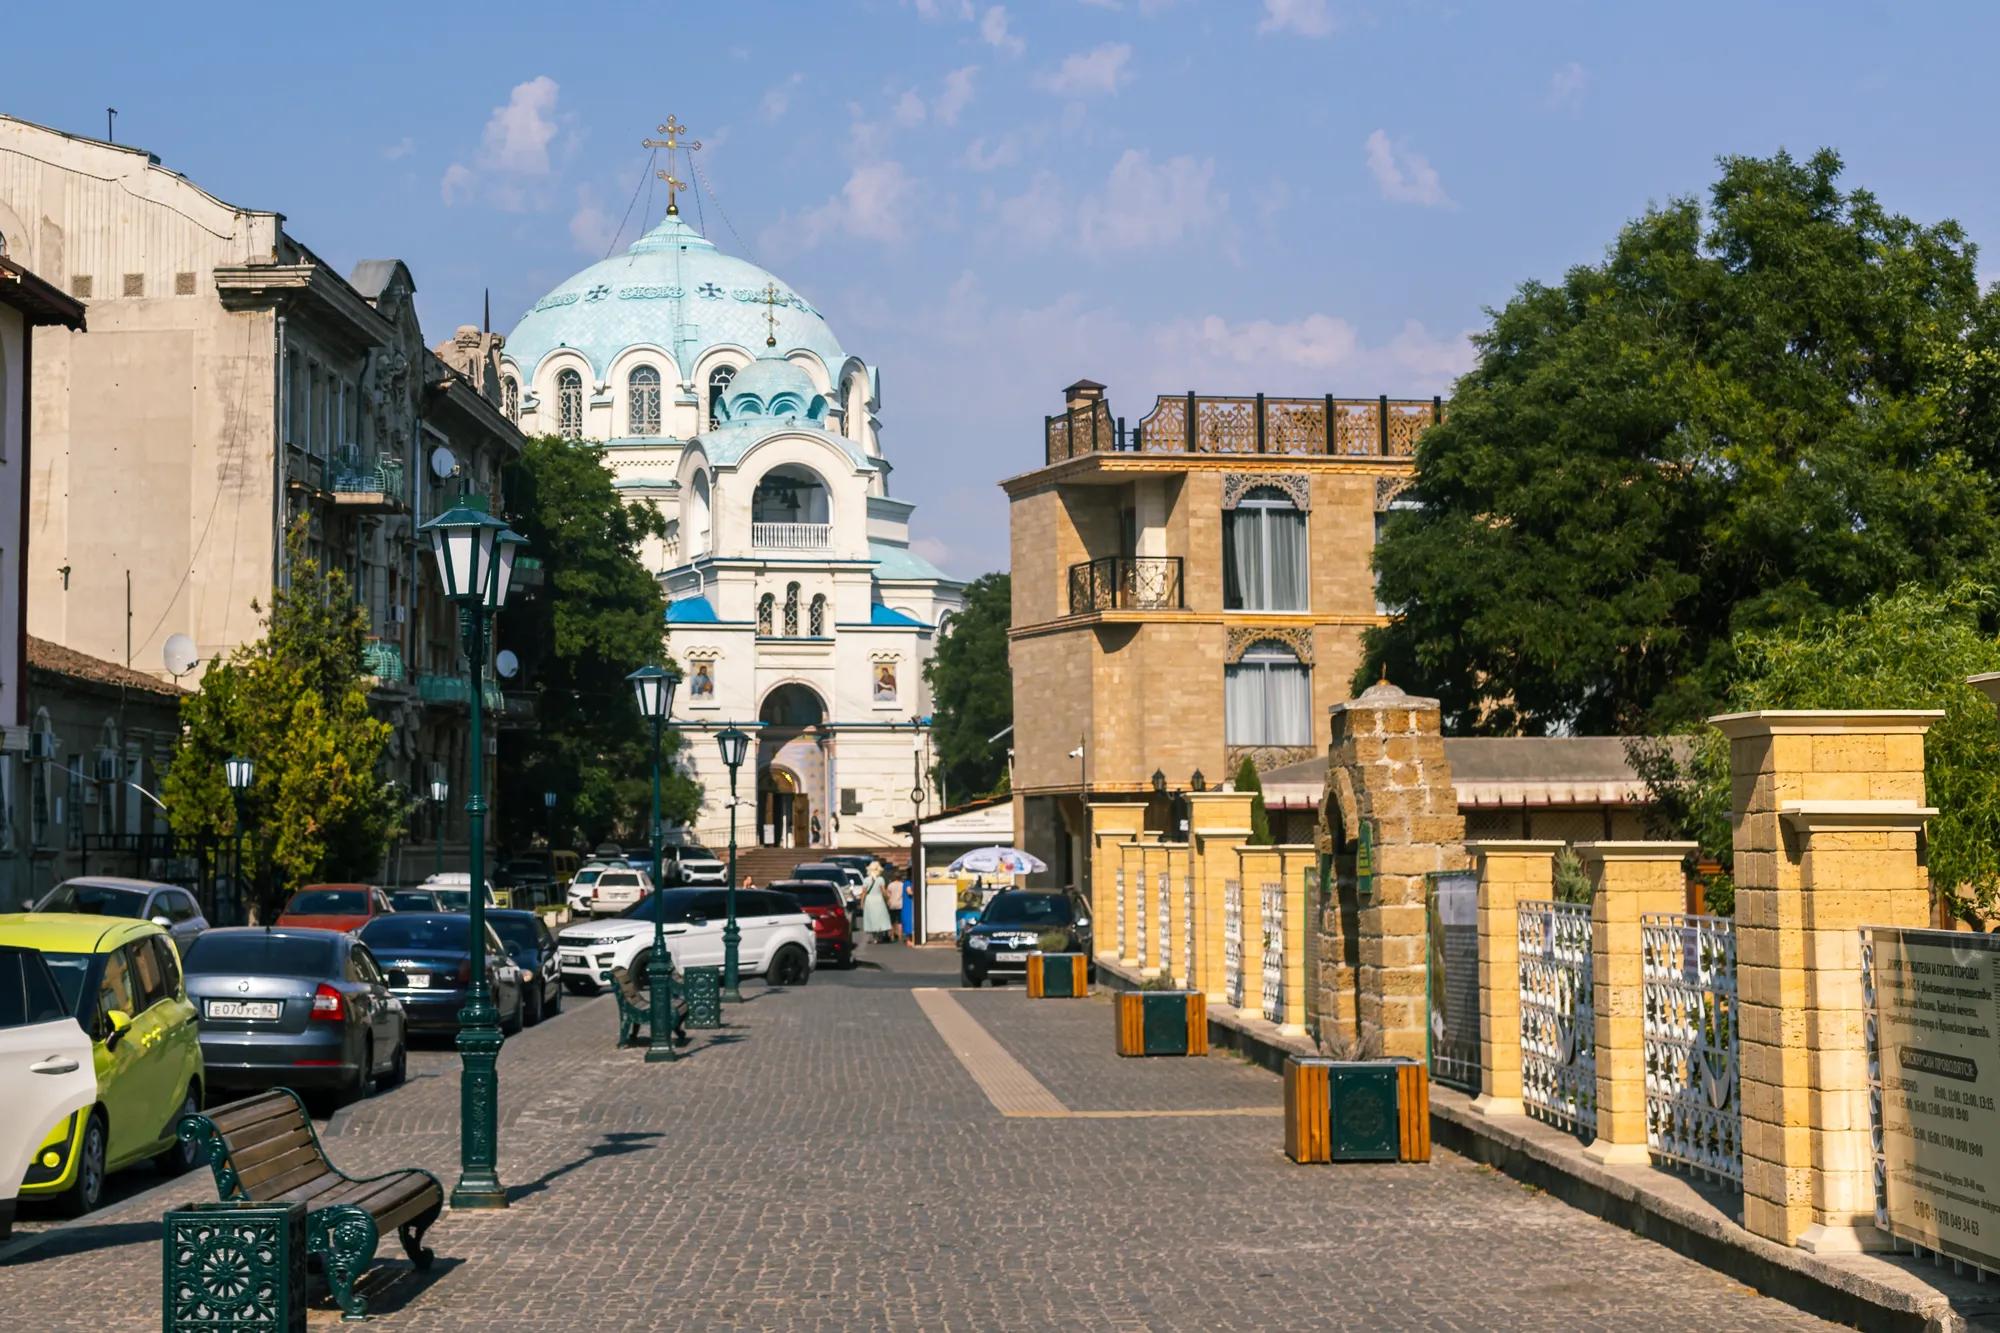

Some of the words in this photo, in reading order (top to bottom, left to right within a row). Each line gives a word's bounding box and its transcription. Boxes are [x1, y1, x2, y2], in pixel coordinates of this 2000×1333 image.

[1936, 964, 1954, 978] ГОСТИ
[1955, 965, 1980, 980] ГОРОДА!
[1938, 1209, 1950, 1226] 978
[1950, 1214, 1962, 1230] 049
[1962, 1217, 1971, 1233] 34
[1971, 1221, 1980, 1237] 63
